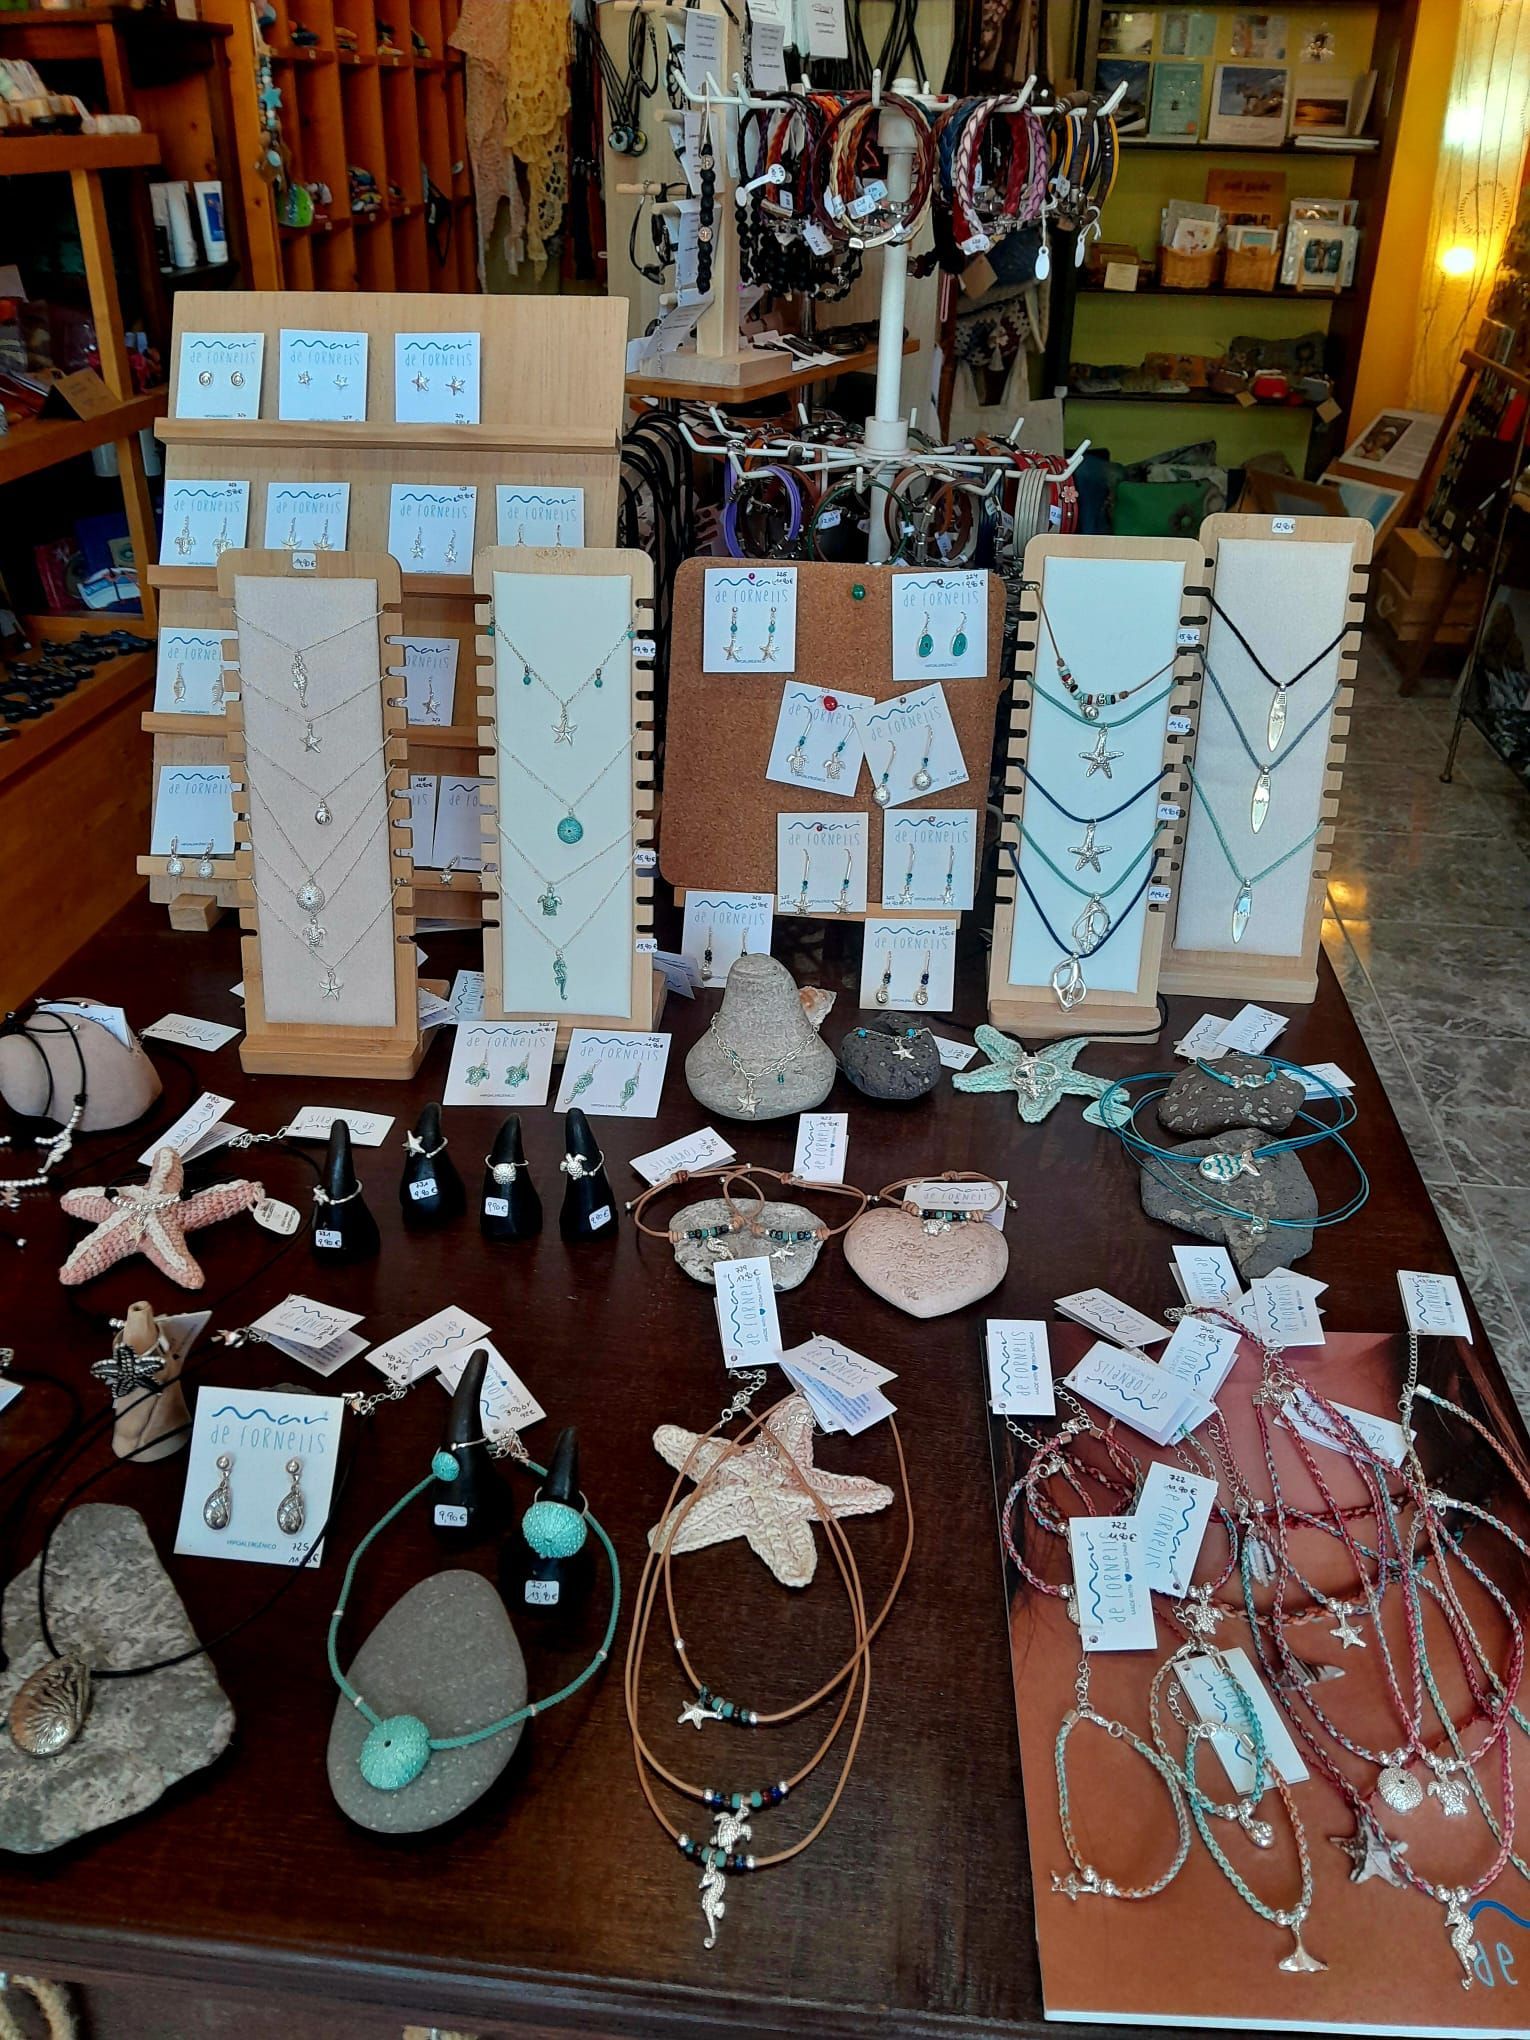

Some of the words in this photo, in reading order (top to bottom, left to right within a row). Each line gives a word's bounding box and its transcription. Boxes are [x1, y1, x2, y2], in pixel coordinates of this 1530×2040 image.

[190, 351, 202, 365] de
[290, 351, 302, 364] de
[405, 353, 417, 367] de
[174, 500, 186, 513] de
[276, 501, 289, 514] de
[401, 504, 412, 518] de
[507, 506, 520, 521] de
[714, 588, 726, 603] de
[903, 593, 915, 606] de
[168, 648, 179, 660] de
[788, 706, 800, 718] de
[871, 727, 885, 742] de
[169, 783, 180, 795] de
[449, 794, 461, 806] de
[788, 832, 800, 846] de
[895, 829, 907, 843] de
[694, 912, 705, 925] de
[874, 937, 887, 950] de
[466, 1036, 481, 1047] de
[579, 1046, 595, 1058] de
[1016, 1384, 1031, 1397] de
[1151, 1389, 1168, 1402] de
[210, 1424, 230, 1444] de
[1169, 1474, 1187, 1485] 722
[438, 1509, 467, 1524] 9,90€
[1111, 1521, 1128, 1530] 722
[292, 1541, 309, 1552] 725
[1108, 1608, 1126, 1623] de
[1473, 1940, 1519, 1988] de
